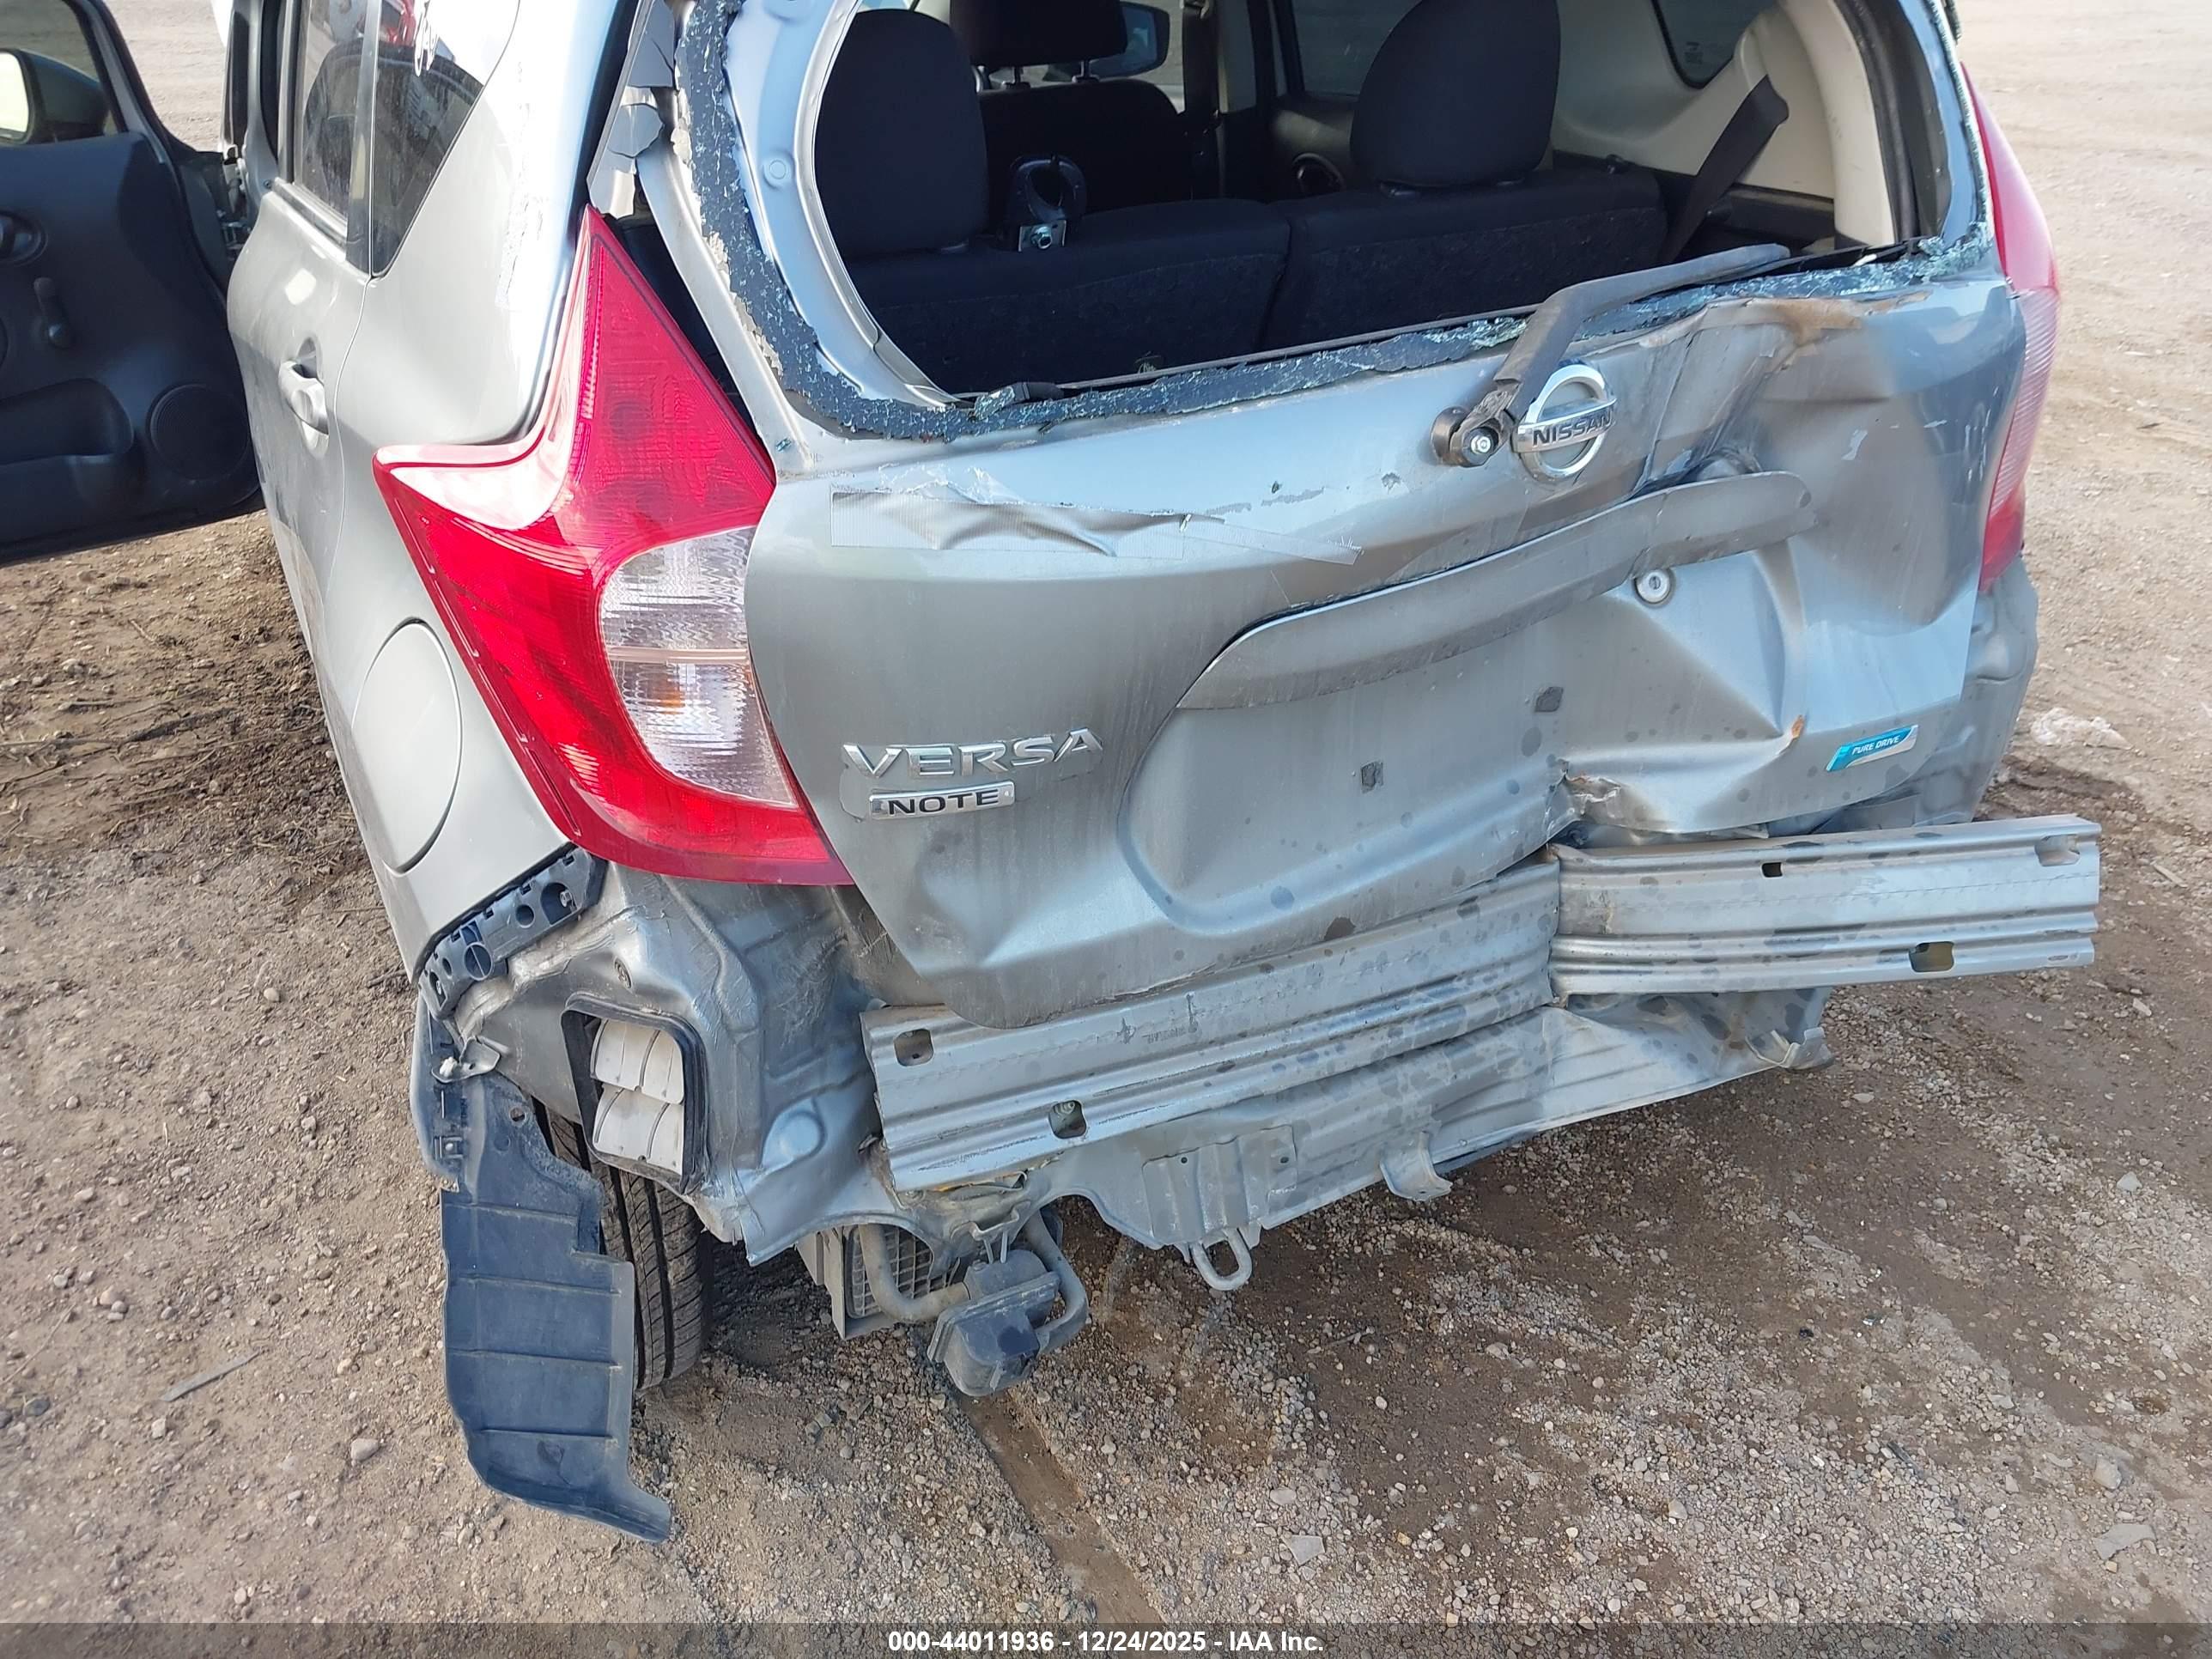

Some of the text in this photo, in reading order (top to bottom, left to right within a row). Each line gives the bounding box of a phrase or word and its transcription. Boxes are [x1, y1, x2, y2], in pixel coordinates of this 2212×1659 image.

[1533, 406, 1612, 447] NISSAN
[842, 728, 1103, 778] VERSA
[1851, 735, 1900, 756] PURE DRIVE
[888, 788, 1000, 815] NOTE
